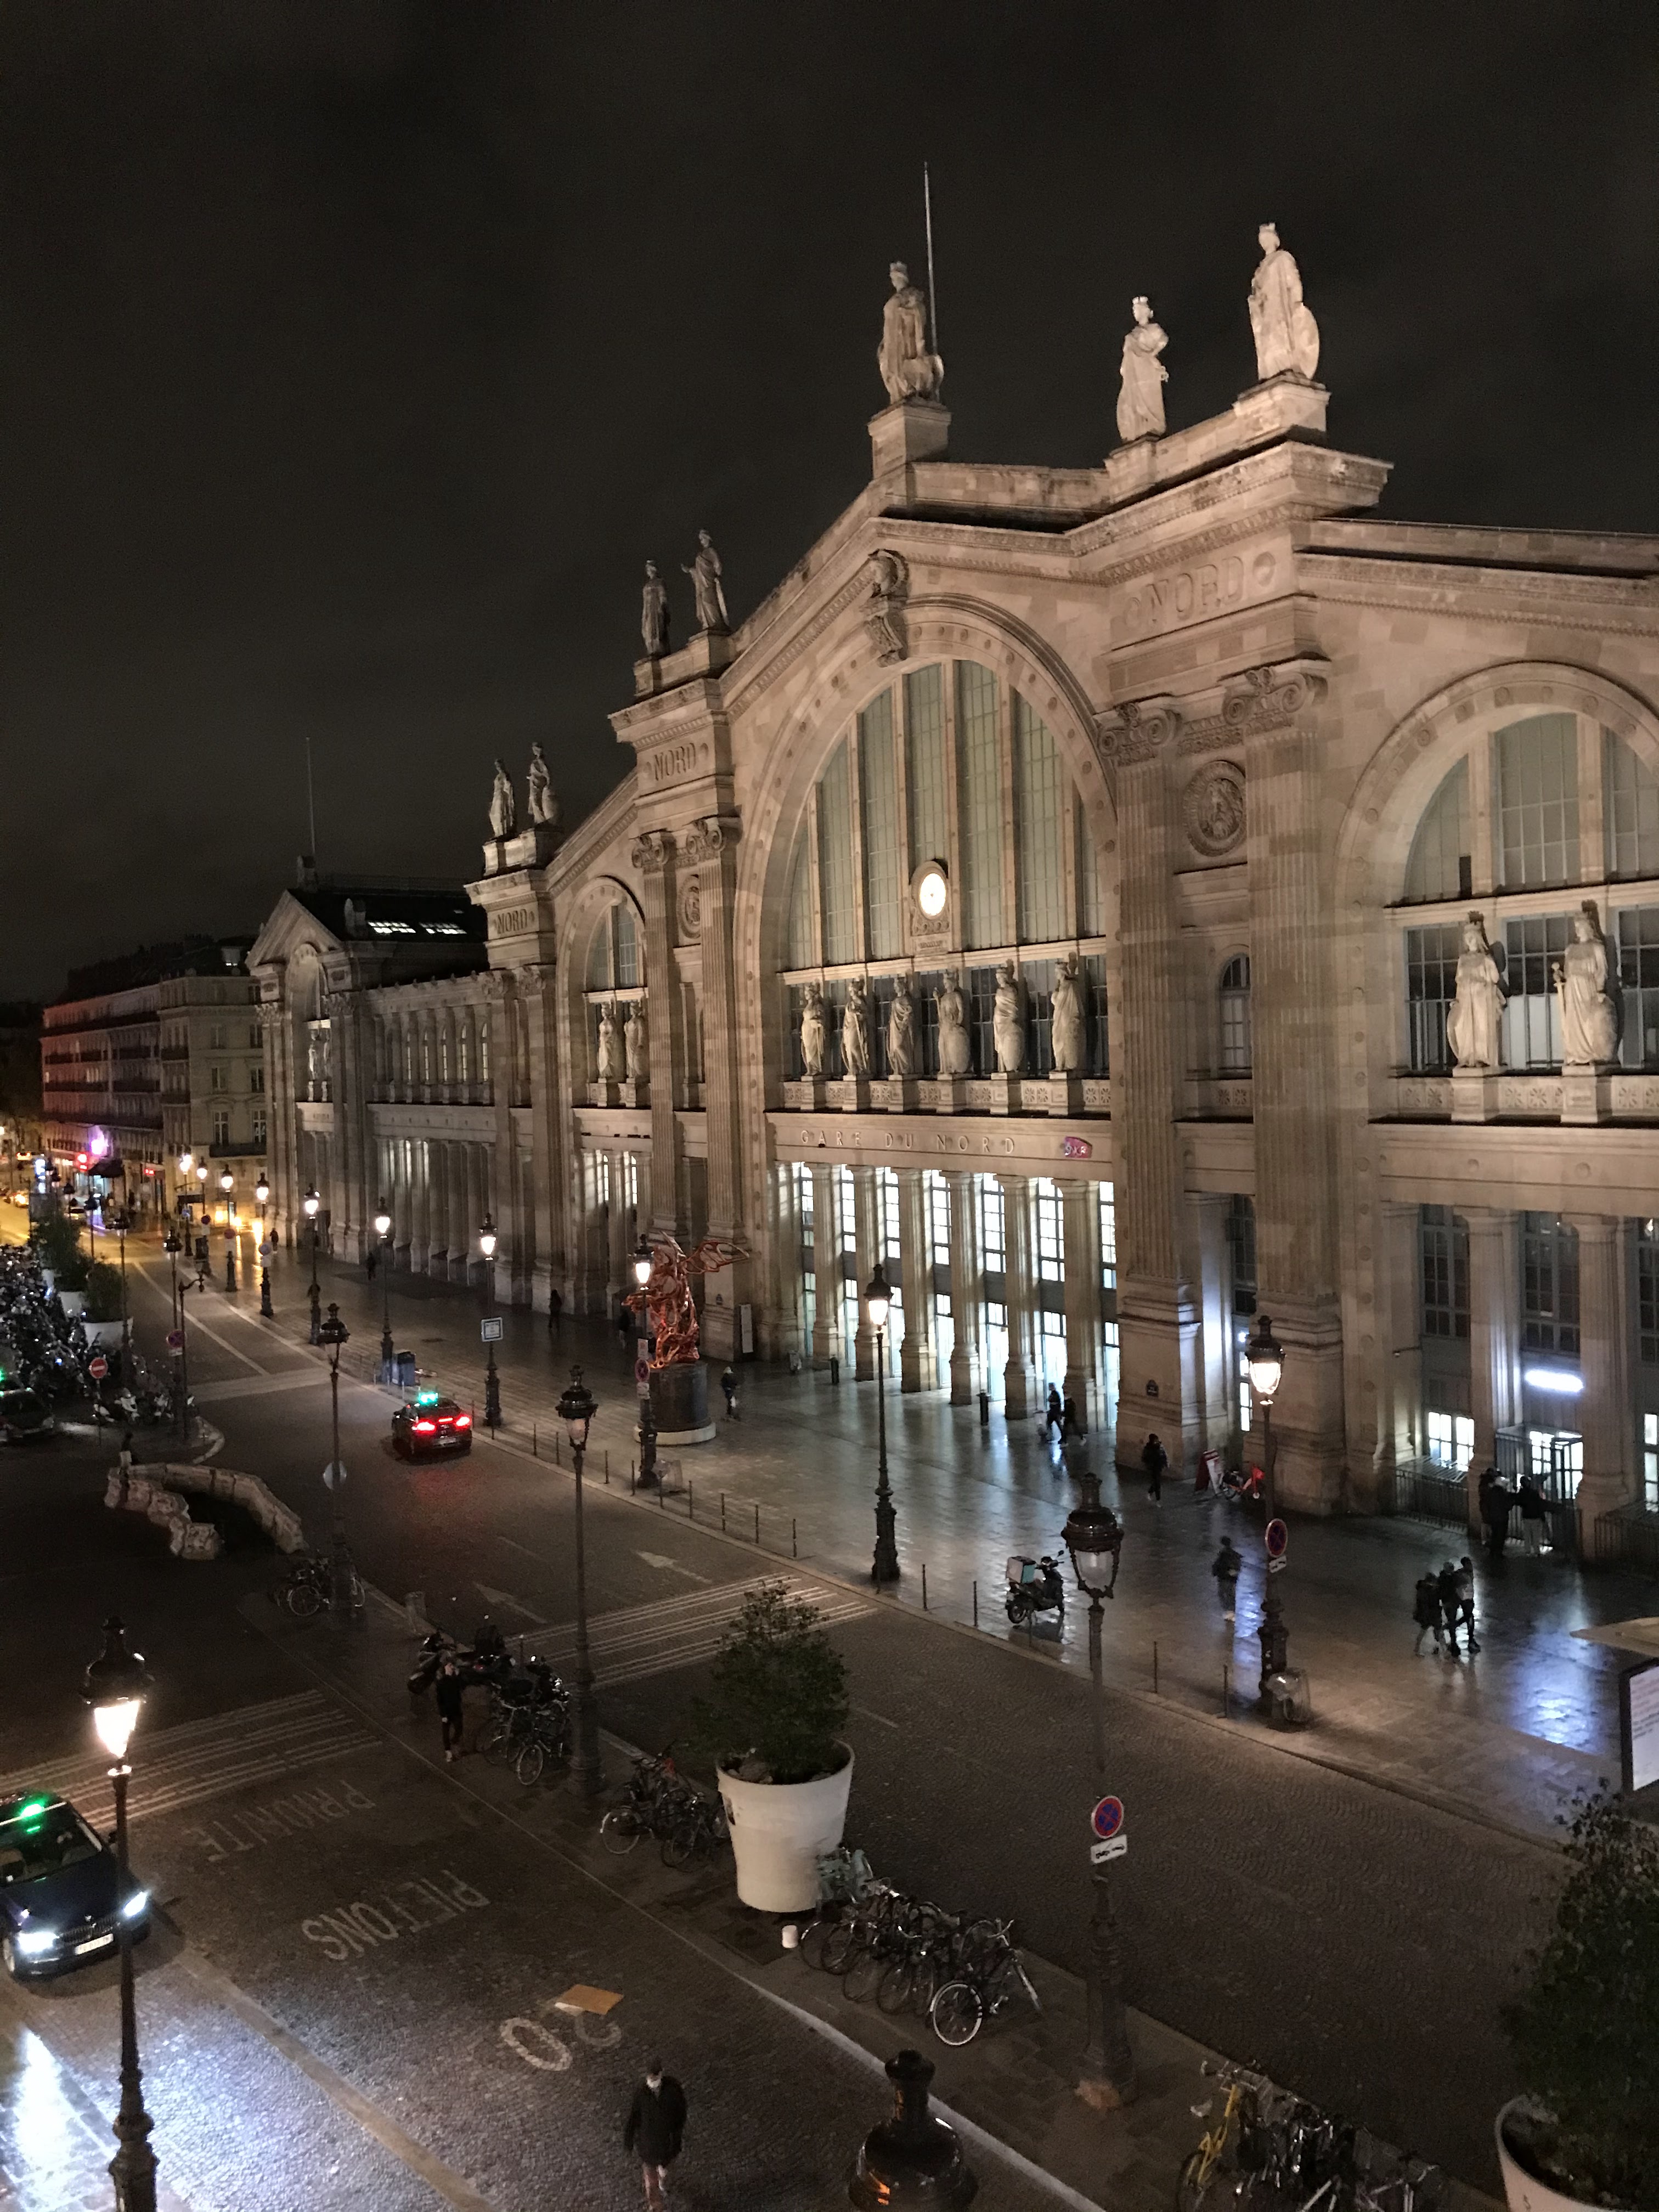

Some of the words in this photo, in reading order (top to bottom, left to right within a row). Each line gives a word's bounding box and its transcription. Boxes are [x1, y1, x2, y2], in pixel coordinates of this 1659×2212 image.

[1146, 556, 1244, 622] NORD
[654, 742, 696, 781] NORD
[497, 909, 528, 934] NORD
[800, 1130, 861, 1147] GARE
[884, 1132, 913, 1149] DU
[936, 1134, 1014, 1154] NORD
